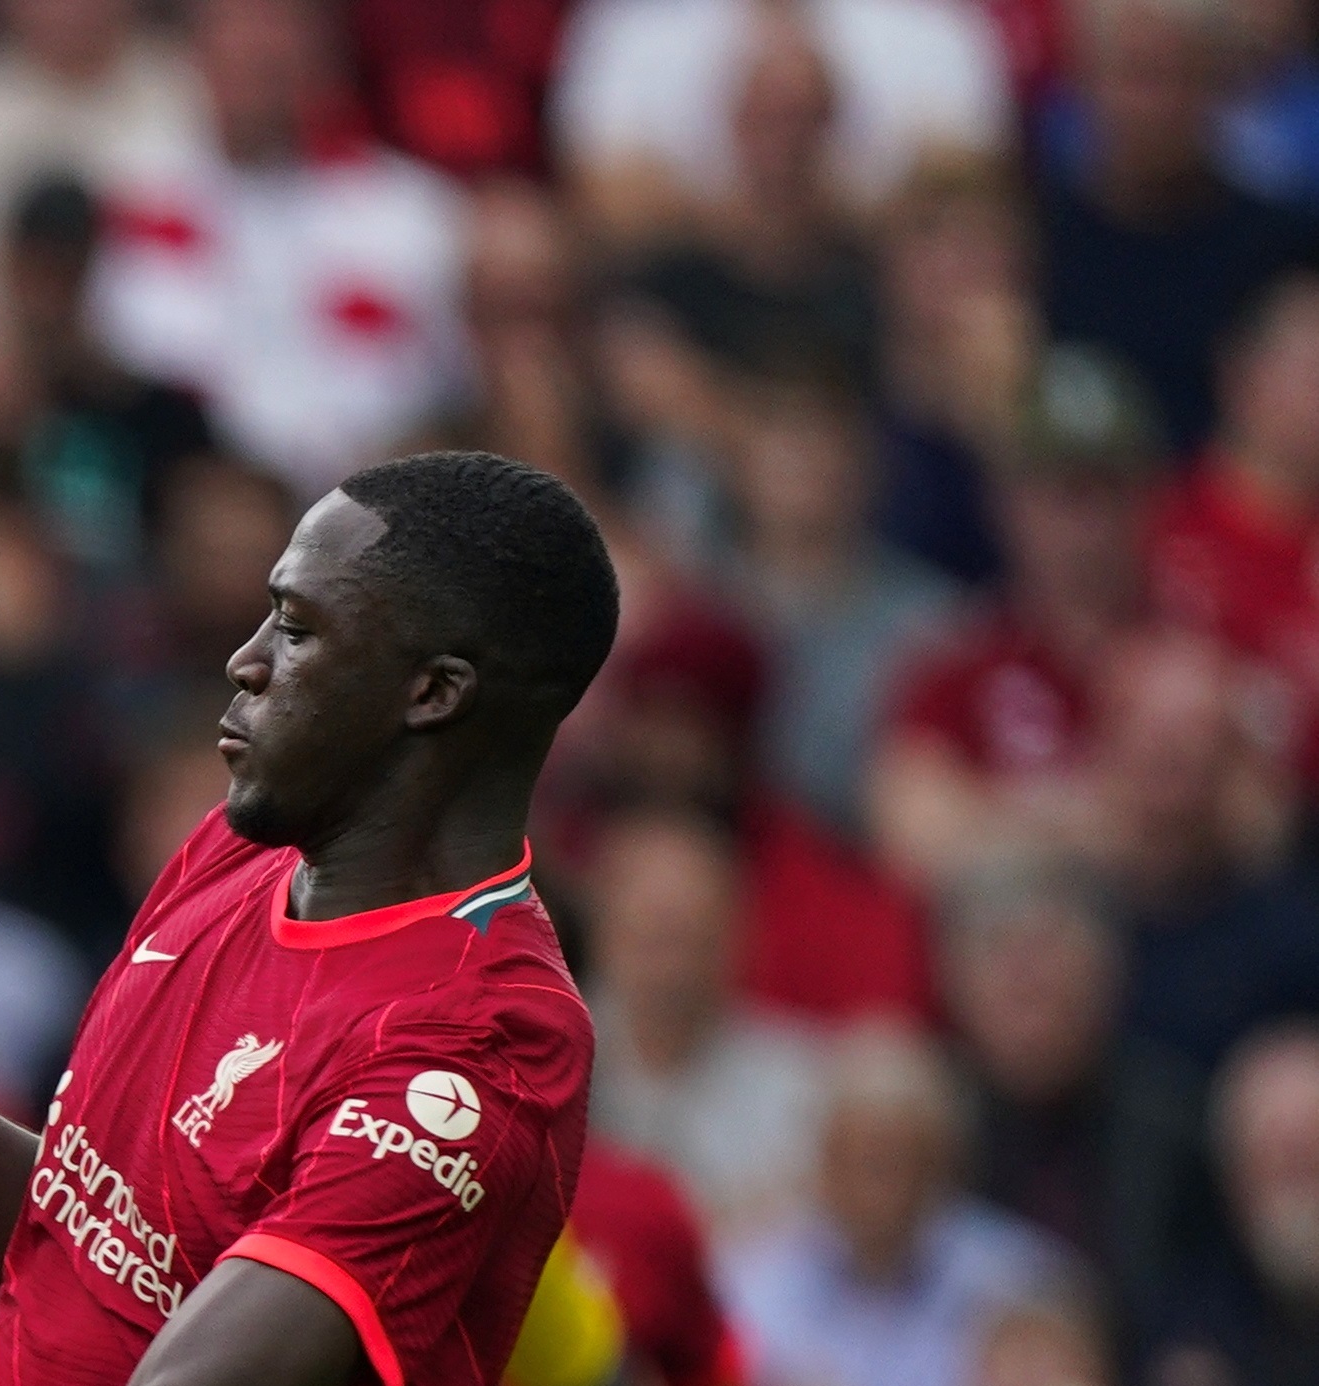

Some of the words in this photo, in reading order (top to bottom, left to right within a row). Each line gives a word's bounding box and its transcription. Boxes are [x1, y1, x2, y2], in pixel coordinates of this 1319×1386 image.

[172, 1101, 212, 1148] LFC
[329, 1098, 486, 1213] Expedia
[31, 1167, 184, 1320] chartered
[53, 1123, 178, 1274] standard
